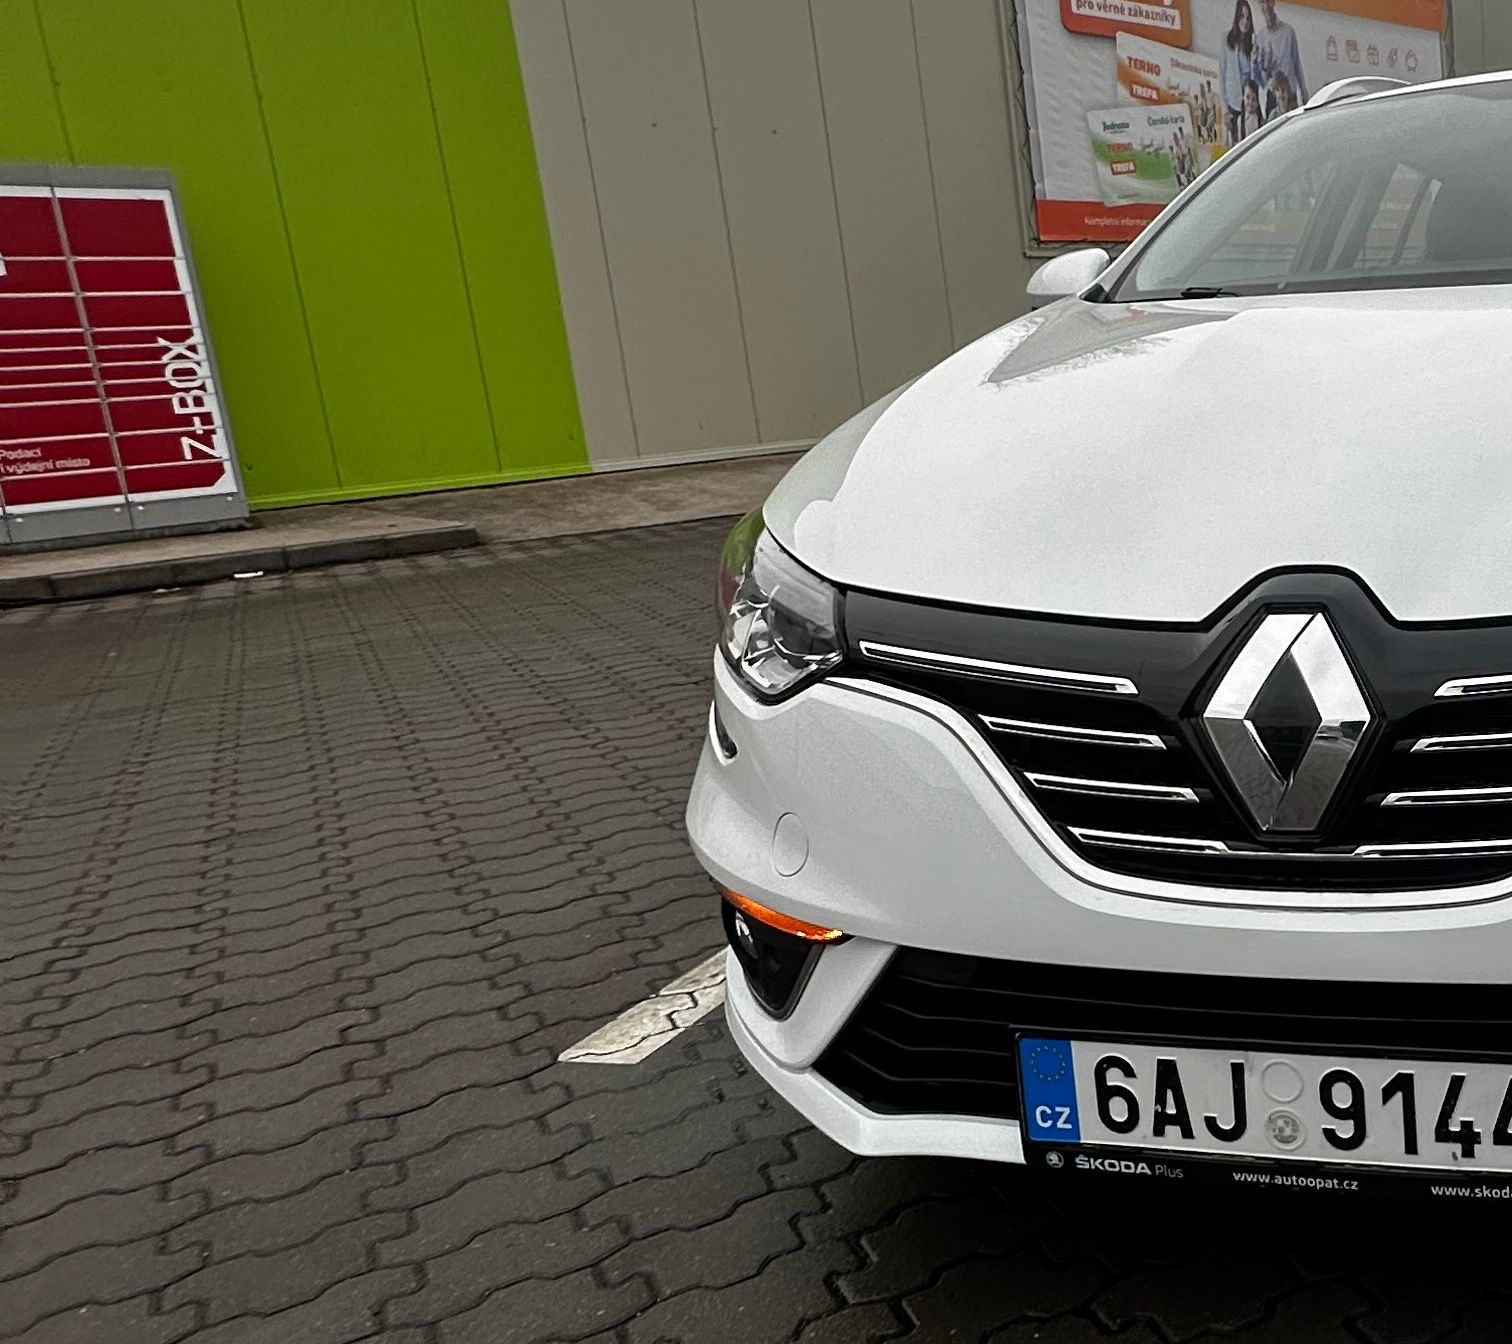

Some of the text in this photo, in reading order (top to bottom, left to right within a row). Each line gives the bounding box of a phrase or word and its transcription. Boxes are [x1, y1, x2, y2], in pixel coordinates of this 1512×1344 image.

[1096, 1, 1126, 16] věrné
[1127, 6, 1176, 26] zákazníky
[1127, 55, 1161, 77] TERNO
[1131, 84, 1159, 101] TREFA
[157, 335, 223, 461] Z-BOX
[1035, 1105, 1073, 1130] CZ
[1093, 1052, 1248, 1143] 6AJ
[1075, 1155, 1152, 1176] ŠKODA
[1155, 1164, 1184, 1179] Plus
[1232, 1171, 1359, 1191] www.autoopat.cz
